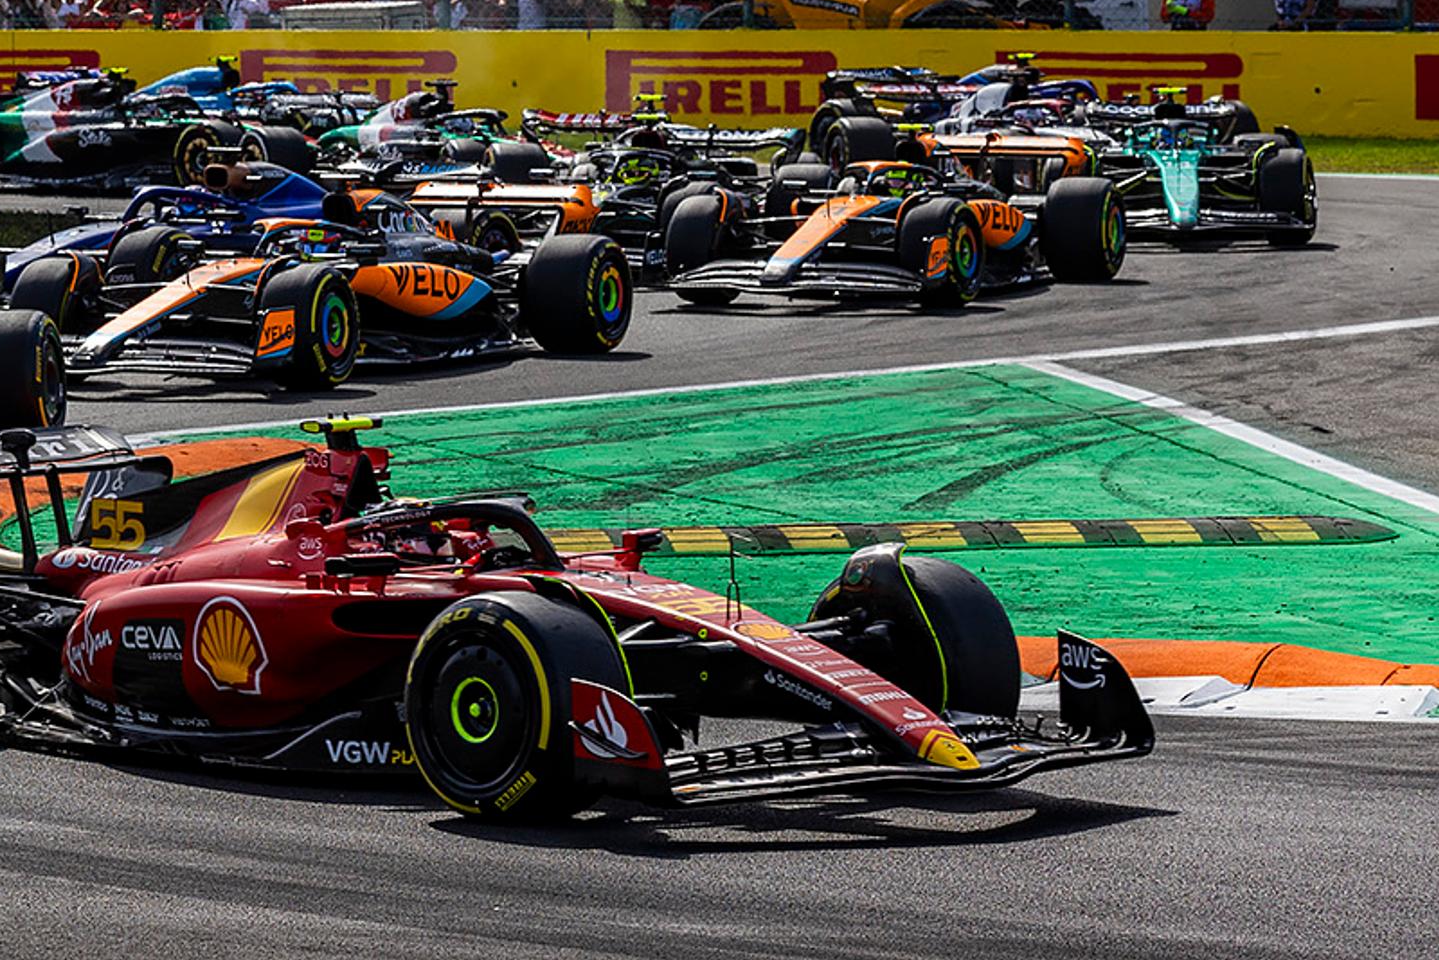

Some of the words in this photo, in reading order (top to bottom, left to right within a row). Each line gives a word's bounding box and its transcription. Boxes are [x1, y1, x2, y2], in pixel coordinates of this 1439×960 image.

[388, 265, 460, 301] VELO
[91, 498, 146, 551] 55
[381, 509, 431, 524] TECHNOLOGY
[299, 536, 323, 549] aws
[1061, 643, 1109, 670] aws
[775, 673, 833, 712] Santander
[325, 739, 390, 764] VGW
[495, 770, 537, 813] PIRELLI
